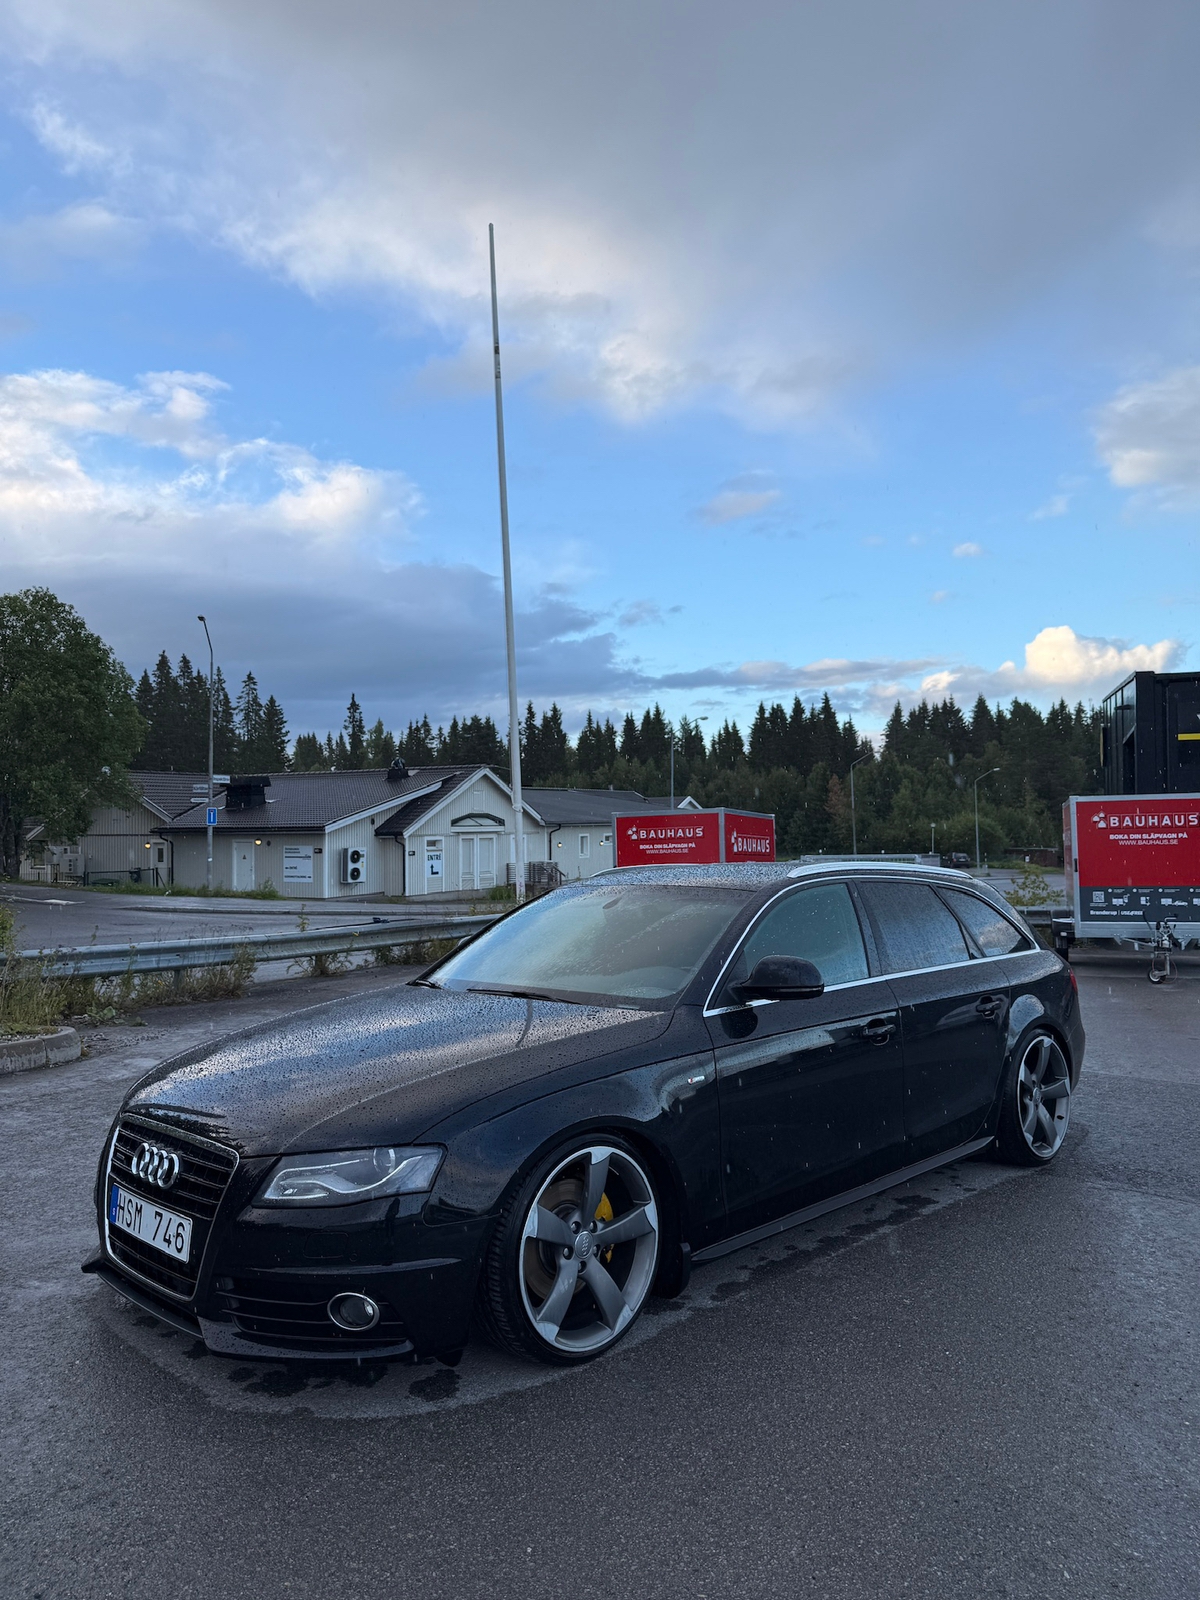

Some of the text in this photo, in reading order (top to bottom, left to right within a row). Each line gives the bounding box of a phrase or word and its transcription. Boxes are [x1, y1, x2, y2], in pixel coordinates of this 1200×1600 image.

[1110, 814, 1198, 827] BAUHAUS
[640, 828, 703, 839] BAUHAUS
[738, 838, 770, 853] BAUHAUS
[117, 1193, 186, 1254] HSM 746
